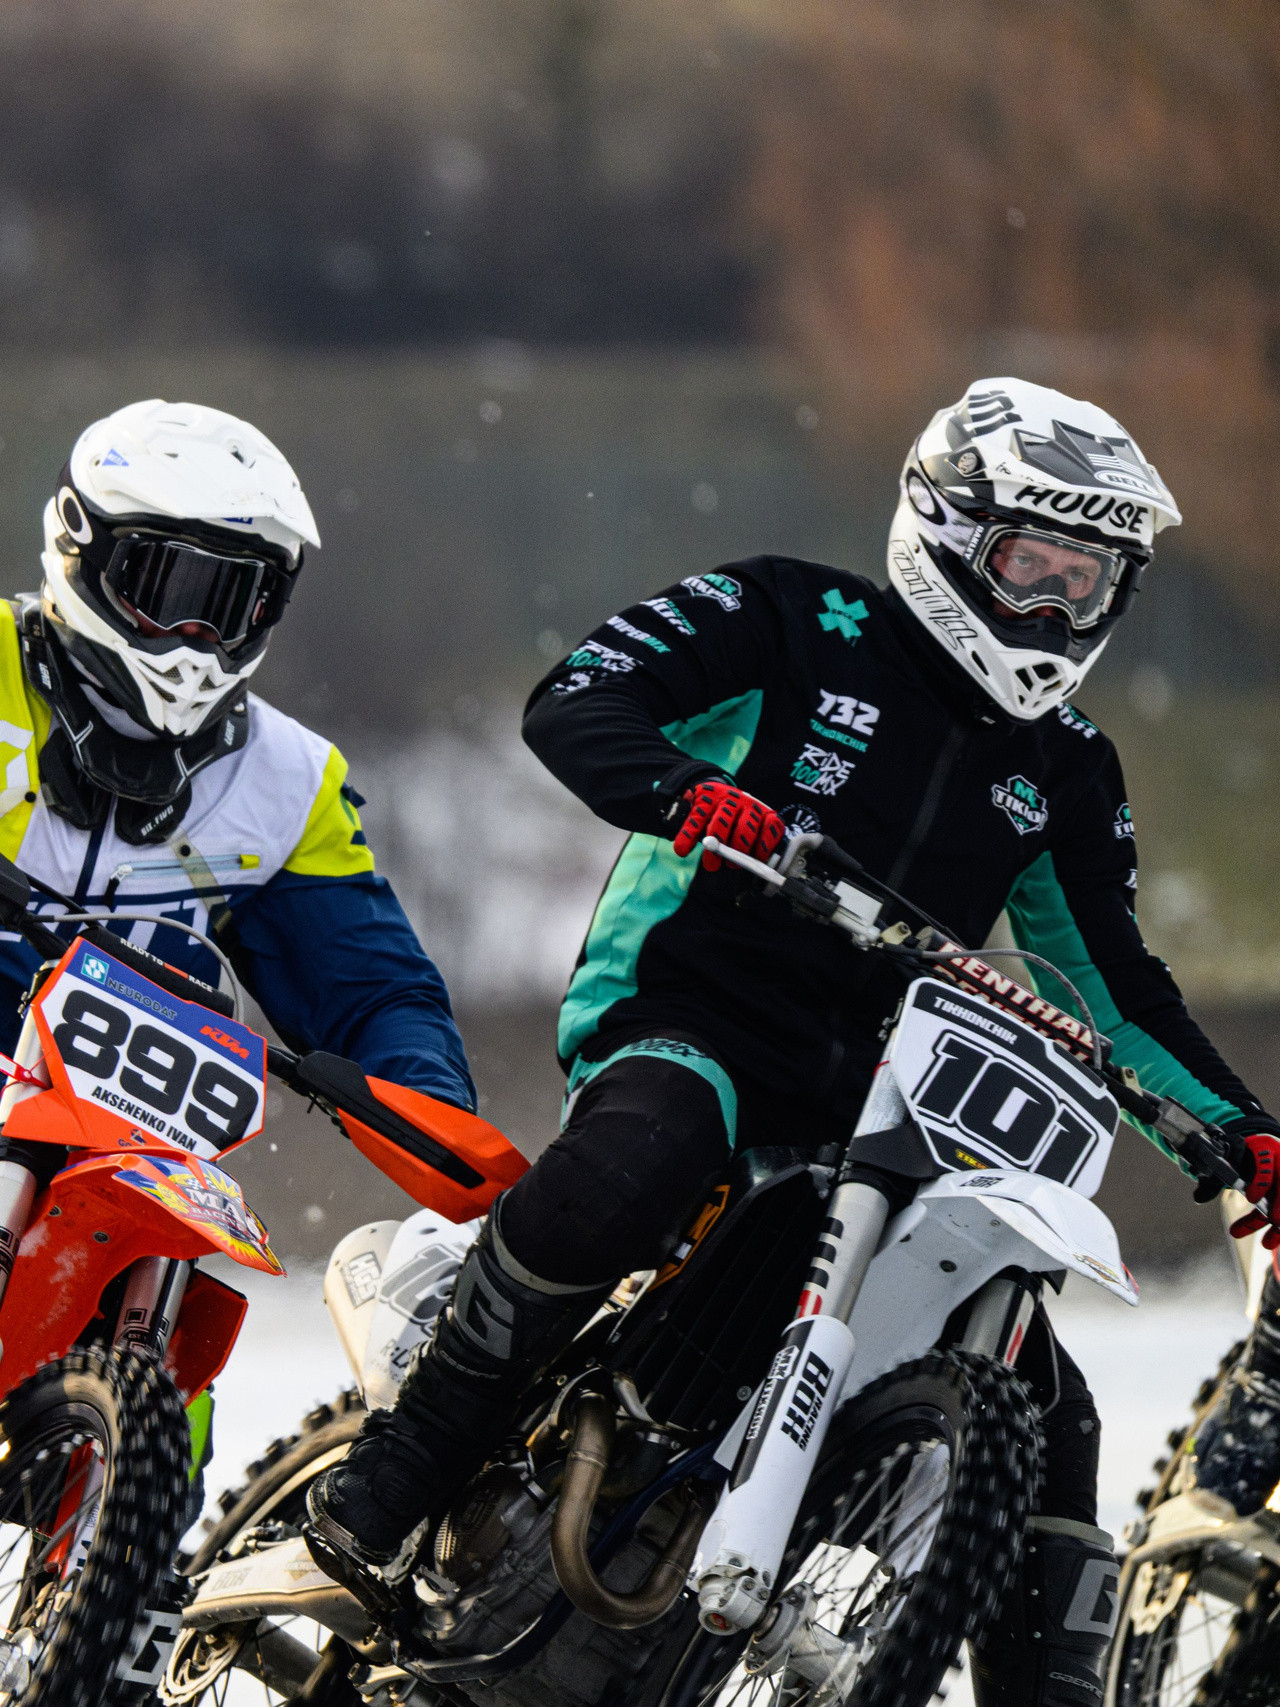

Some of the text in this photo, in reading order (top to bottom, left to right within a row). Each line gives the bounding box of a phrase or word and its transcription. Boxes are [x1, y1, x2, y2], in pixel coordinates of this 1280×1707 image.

[1105, 472, 1152, 493] BELL
[1014, 484, 1150, 535] HOUSE
[964, 524, 984, 561] OAKLEY
[120, 937, 214, 993] READY TO RACE
[106, 977, 178, 1021] NEURODAT
[933, 995, 1019, 1046] TIKHONCHIK
[937, 940, 1101, 1051] RENTHAL
[198, 1024, 251, 1060] KTM
[52, 988, 259, 1152] 899
[90, 1084, 198, 1153] AKSENENKO IVAN
[913, 1034, 1099, 1188] 101
[348, 1252, 380, 1302] HGS
[798, 1396, 824, 1453] RACING
